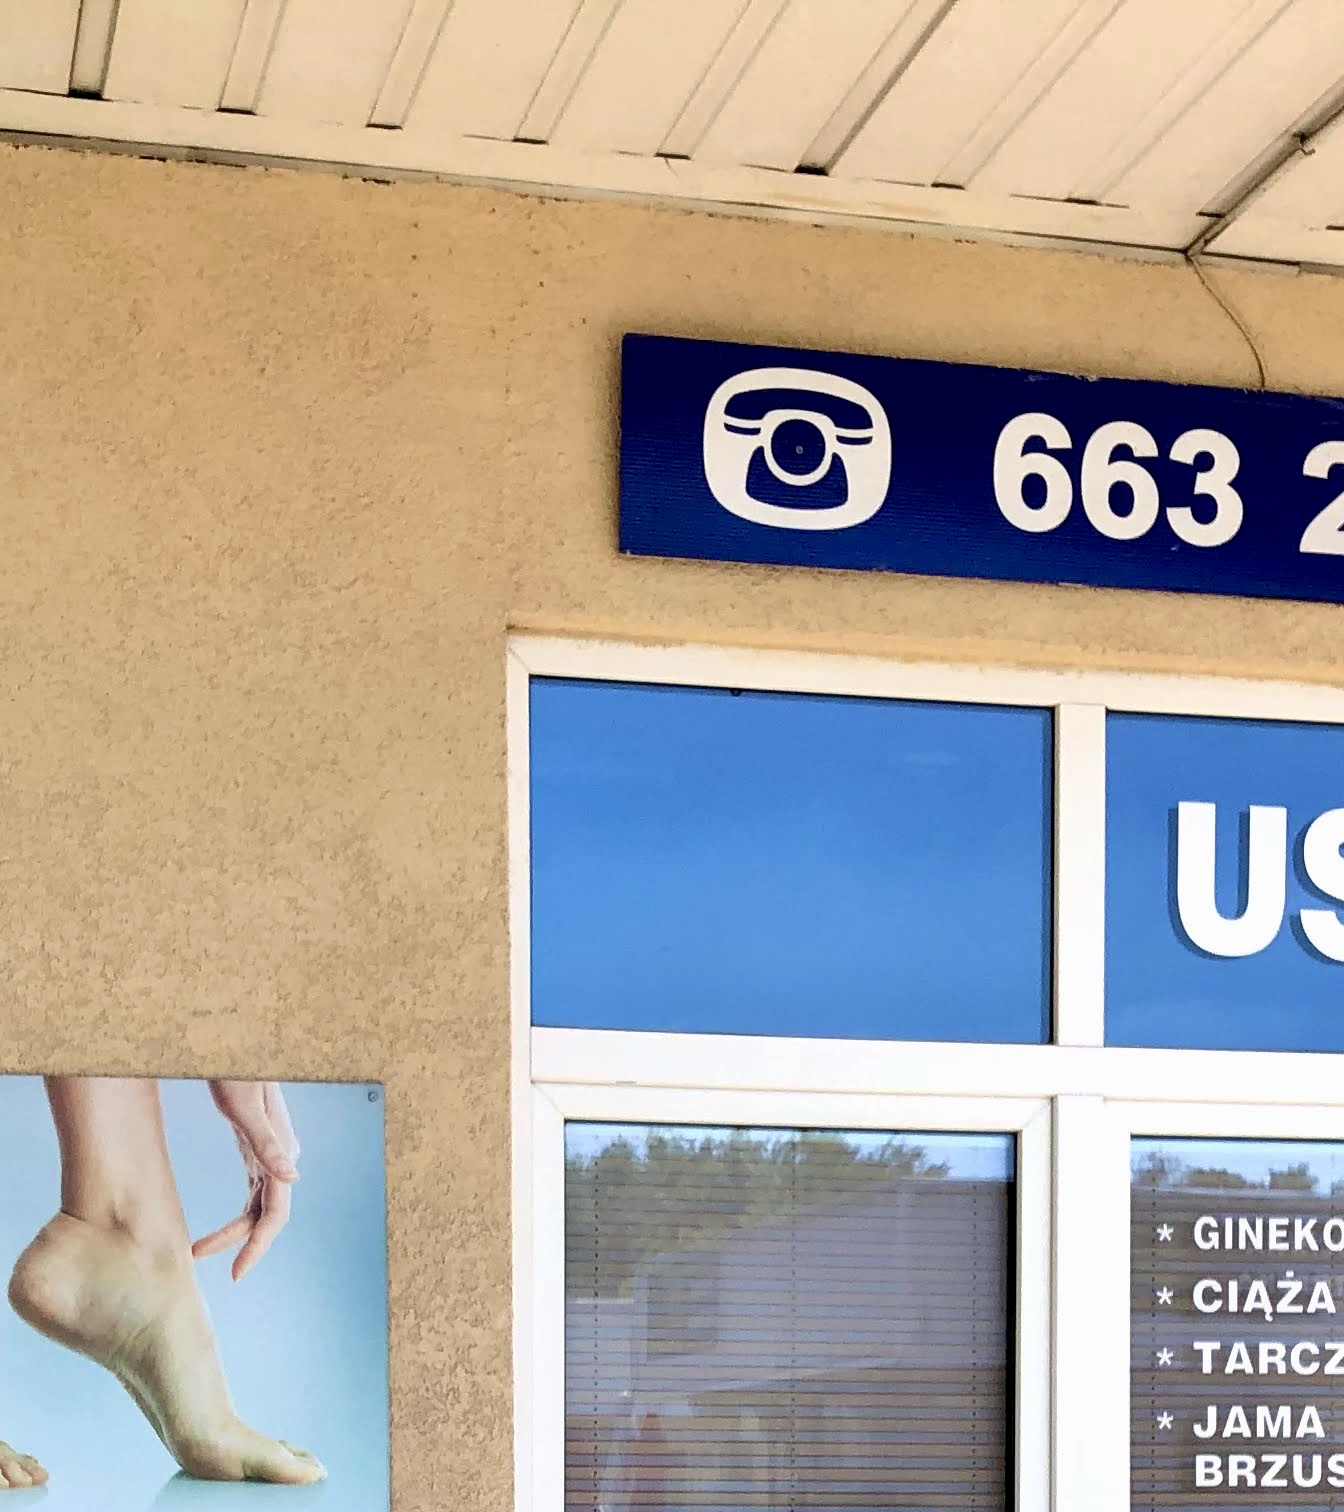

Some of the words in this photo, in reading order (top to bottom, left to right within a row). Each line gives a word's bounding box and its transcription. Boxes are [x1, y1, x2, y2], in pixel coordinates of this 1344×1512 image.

[994, 413, 1243, 547] 663
[1193, 1270, 1336, 1322] CIĄŻA
[1194, 1405, 1325, 1438] JAMA
